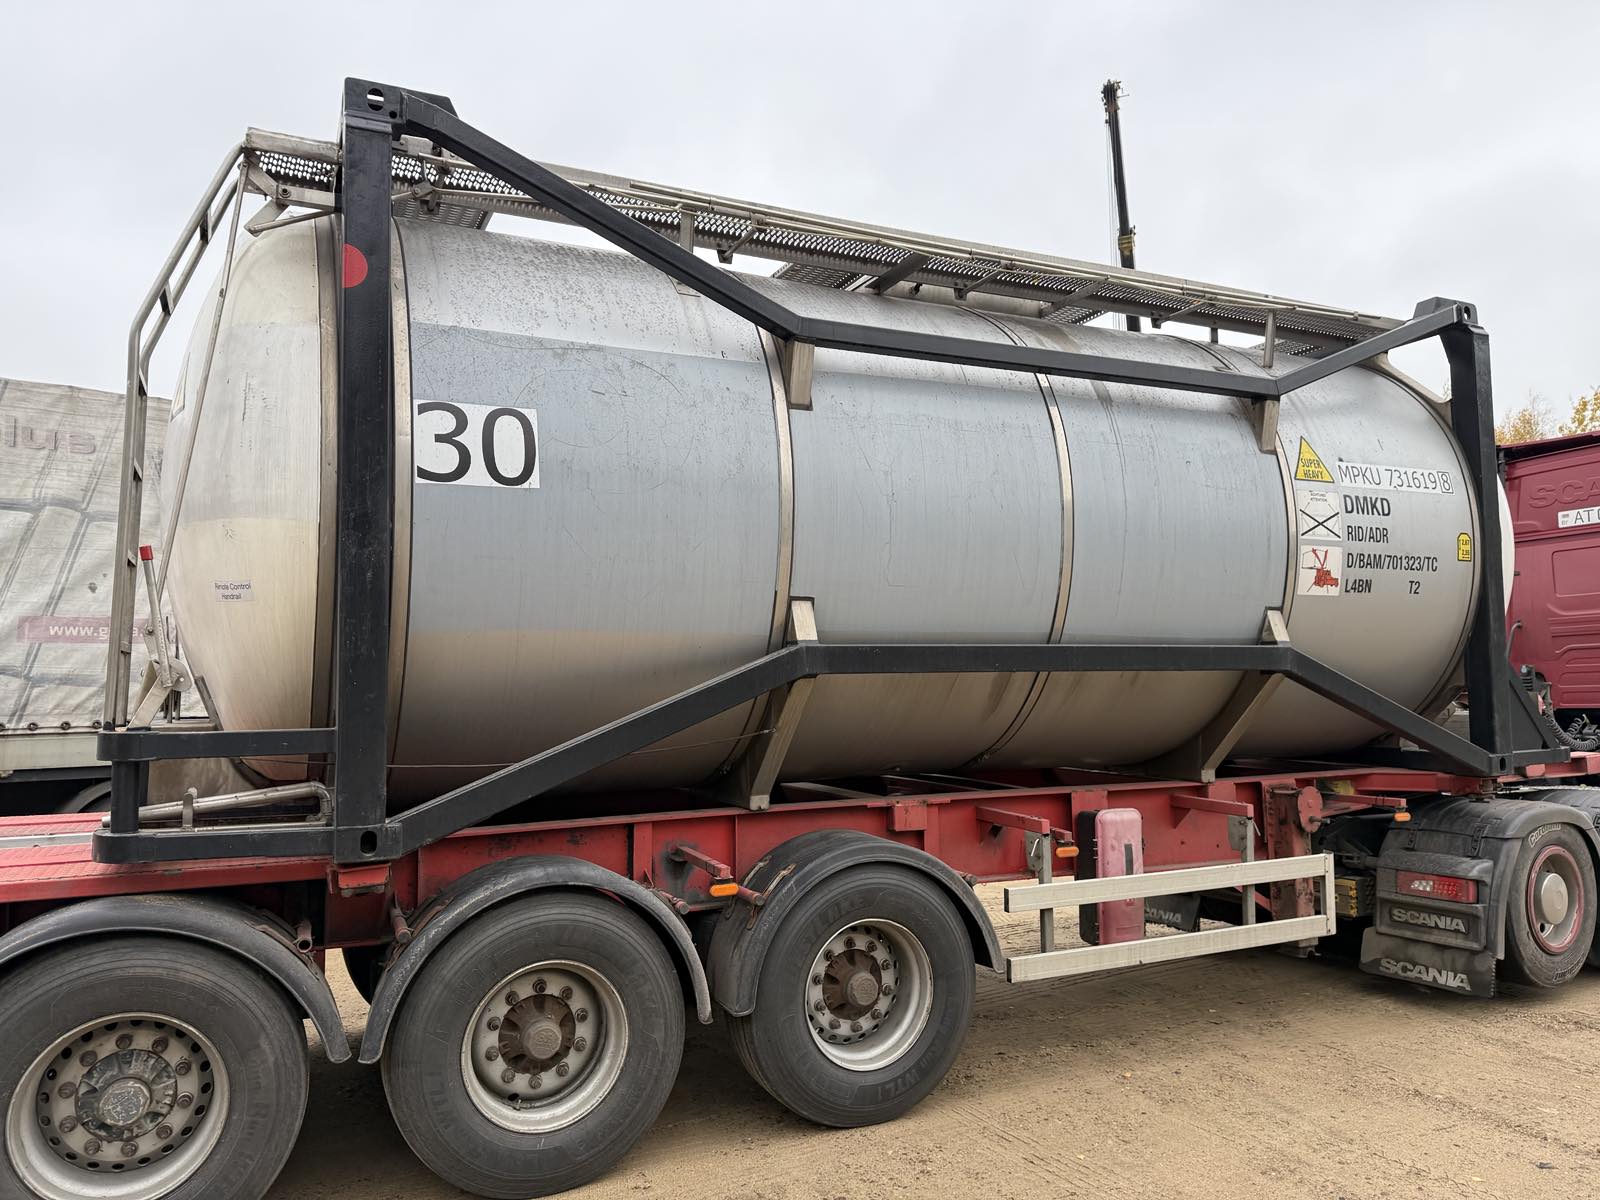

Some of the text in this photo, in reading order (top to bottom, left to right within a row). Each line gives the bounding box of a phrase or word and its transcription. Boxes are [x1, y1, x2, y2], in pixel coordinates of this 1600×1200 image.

[416, 401, 536, 487] 30
[1300, 458, 1322, 469] SUPER
[1303, 469, 1324, 480] HEAVY
[1338, 464, 1451, 492] MPKU 731619 8
[1343, 494, 1391, 517] DMKD
[1346, 525, 1389, 544] RID/ADR
[1346, 552, 1438, 572] D/BAM/701323/TC
[1344, 578, 1421, 594] L4BN T2
[50, 624, 143, 640] www.ga.
[1391, 908, 1466, 933] SCANIA
[1379, 958, 1472, 991] SCANIA
